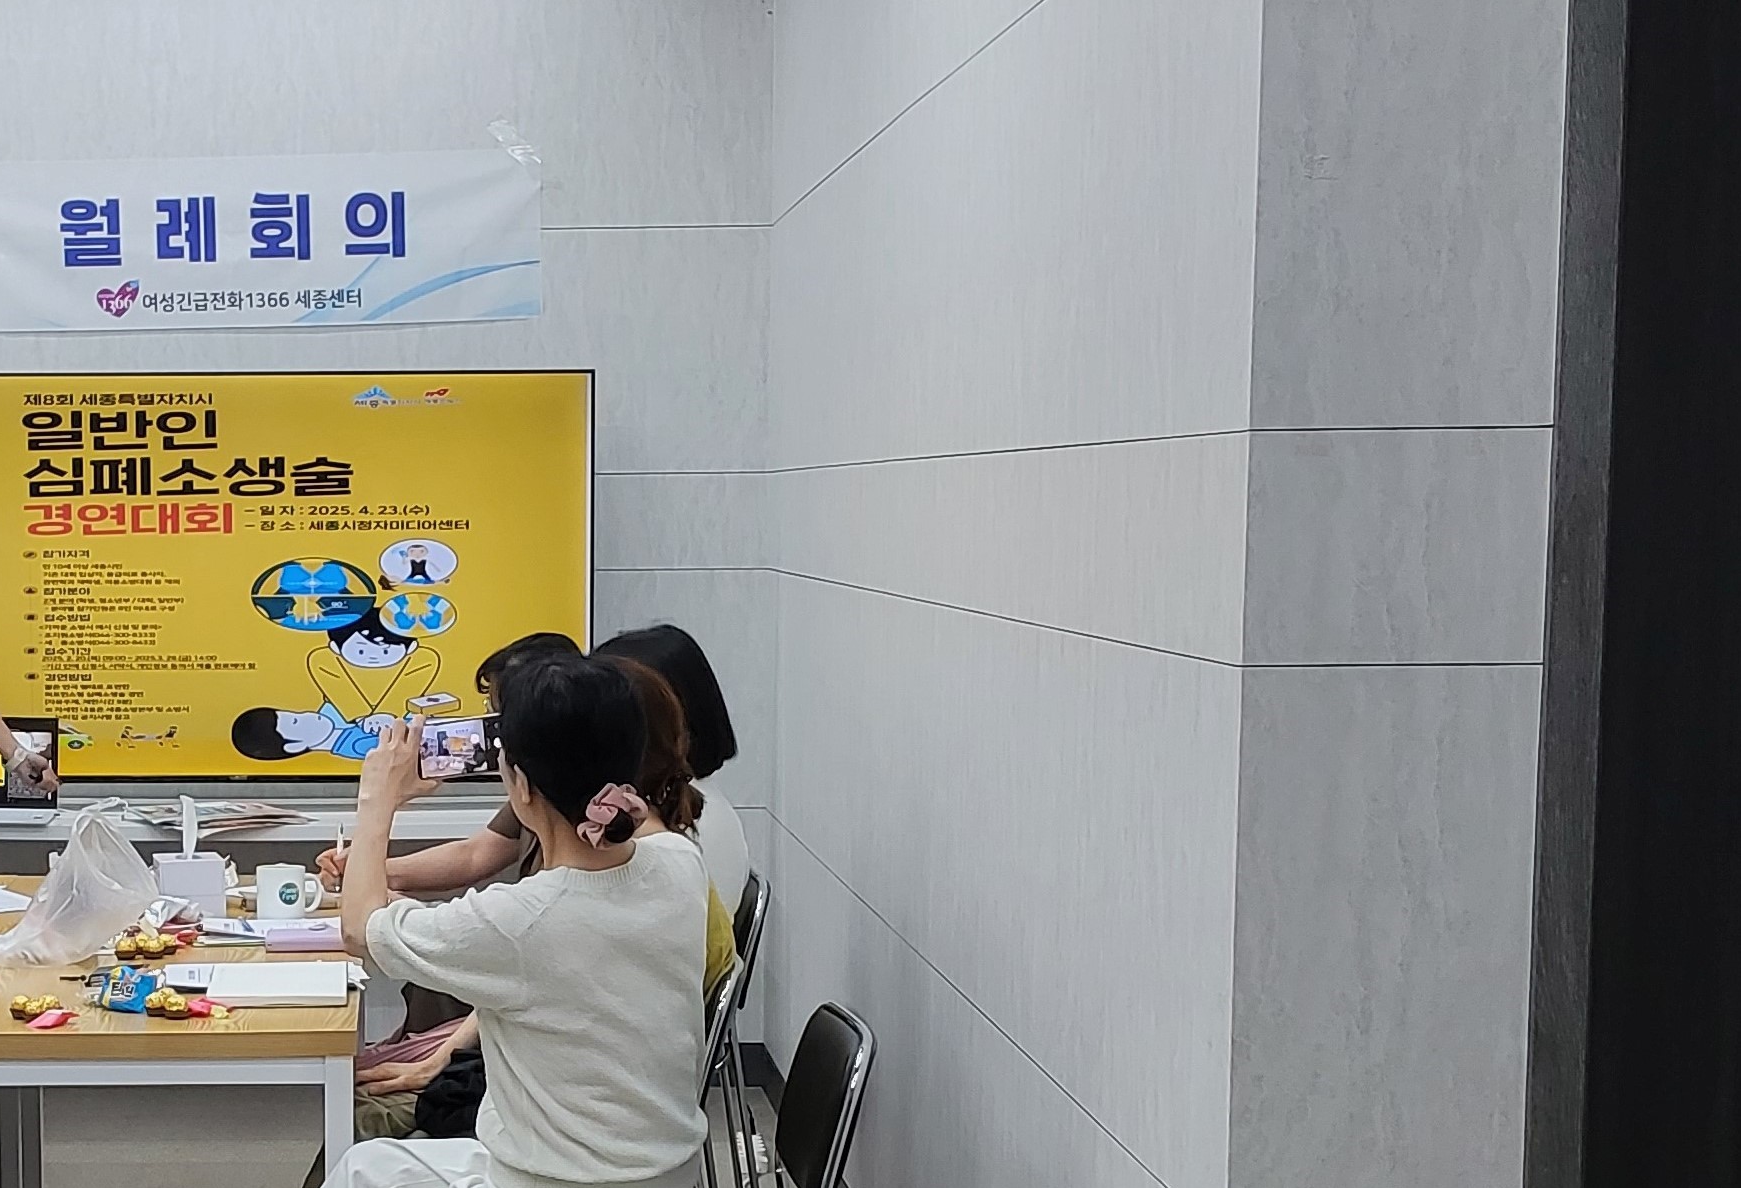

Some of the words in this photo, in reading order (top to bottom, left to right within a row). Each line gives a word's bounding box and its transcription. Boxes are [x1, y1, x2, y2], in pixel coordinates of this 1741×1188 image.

[143, 291, 289, 313] 여성긴급전화1366
[294, 288, 362, 309] 세종센터
[23, 393, 74, 406] 제8회
[79, 392, 214, 406] 세종특별자치시
[21, 409, 218, 451] 일반인
[23, 455, 354, 498] 심폐소생술
[23, 502, 234, 536] 경연대회
[308, 505, 355, 516] 2025.
[359, 505, 374, 516] 4.
[378, 504, 430, 516] 23.(수)
